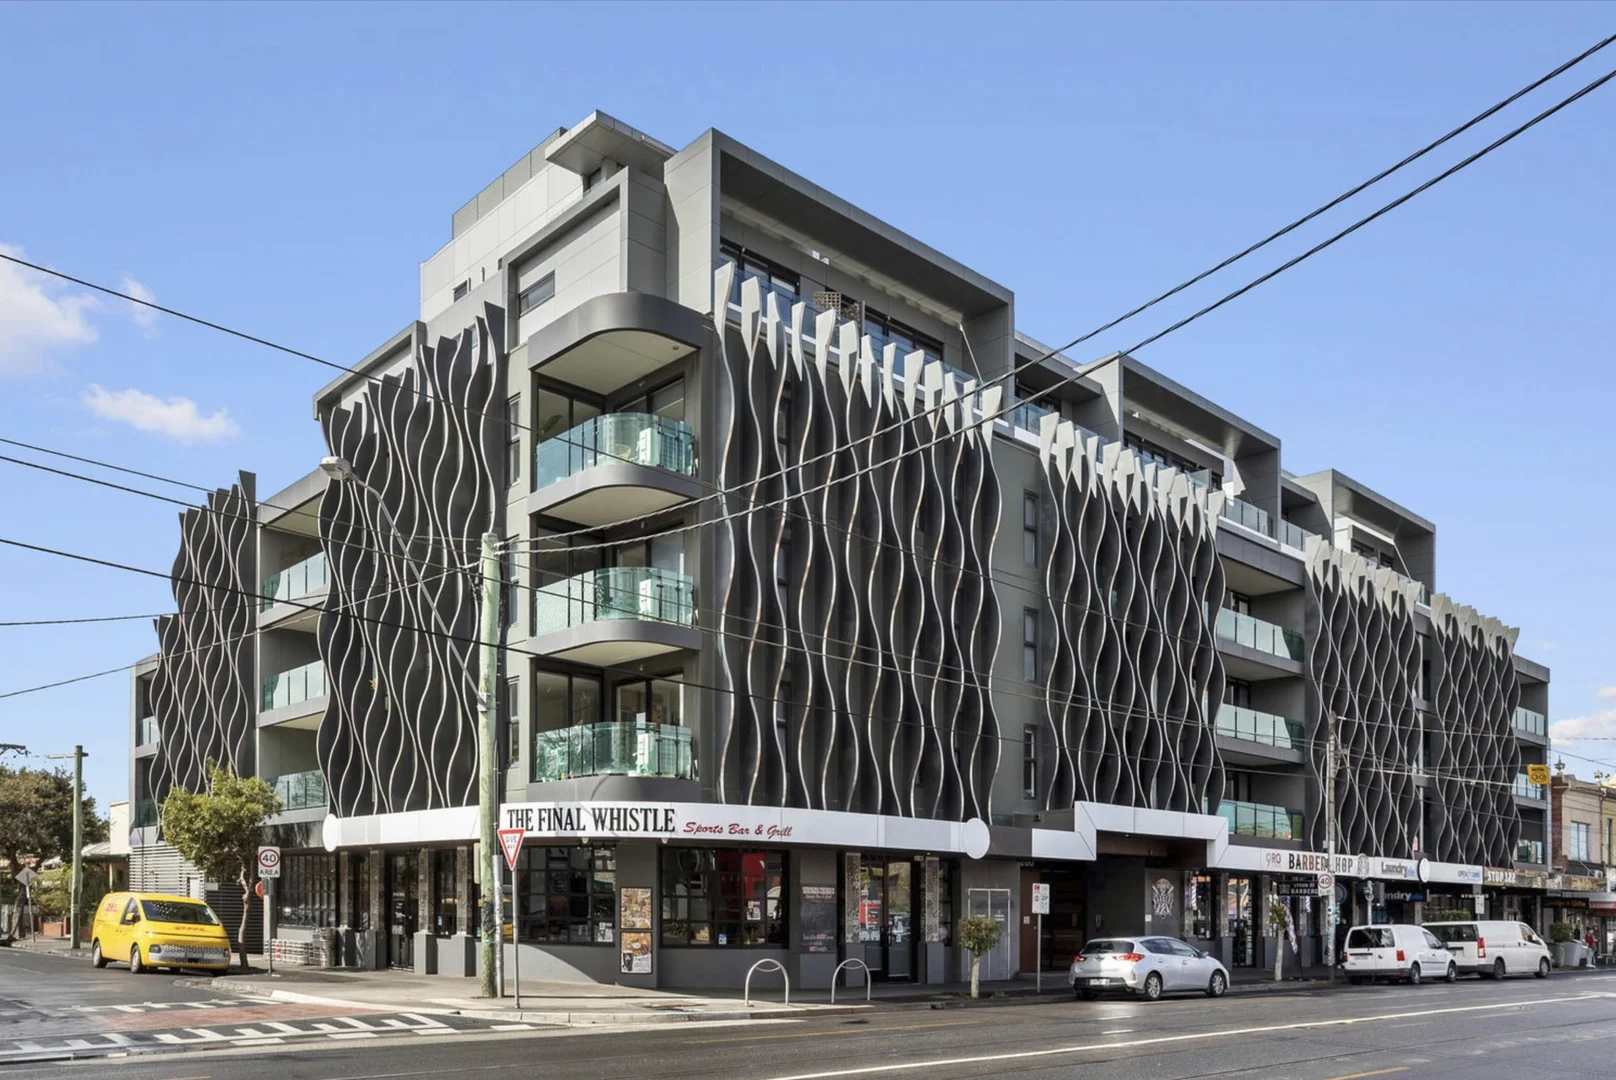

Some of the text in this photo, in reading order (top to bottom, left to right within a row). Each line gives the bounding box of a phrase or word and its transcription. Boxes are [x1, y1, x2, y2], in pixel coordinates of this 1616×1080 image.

[507, 807, 675, 832] THE FINAL WHISTLE
[683, 822, 792, 839] Sports Bar & Grill
[262, 854, 276, 862] 40
[1320, 877, 1329, 886] 40
